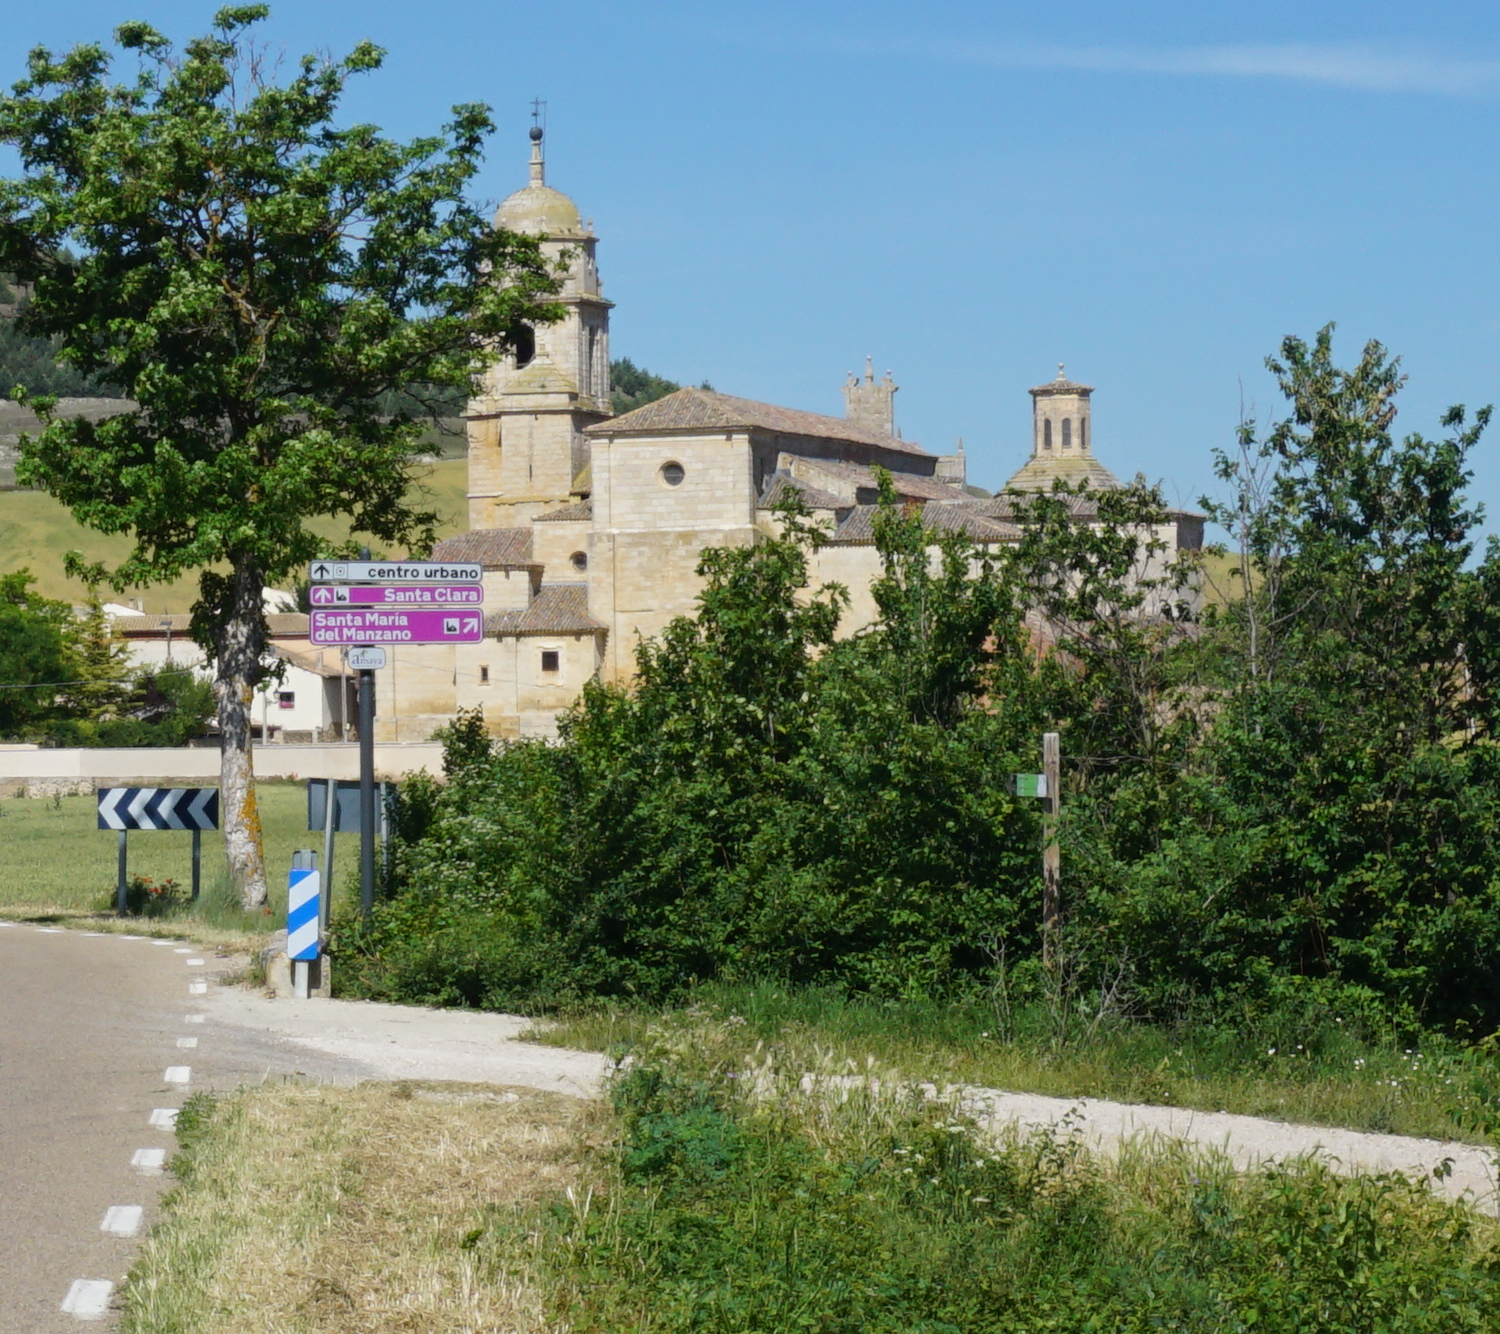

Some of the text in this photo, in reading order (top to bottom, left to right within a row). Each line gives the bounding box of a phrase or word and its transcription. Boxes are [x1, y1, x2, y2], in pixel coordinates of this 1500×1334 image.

[368, 567, 478, 579] centro urbano
[384, 589, 478, 601] Santa Clara
[315, 612, 408, 626] Santa María
[315, 629, 411, 641] del Manzano
